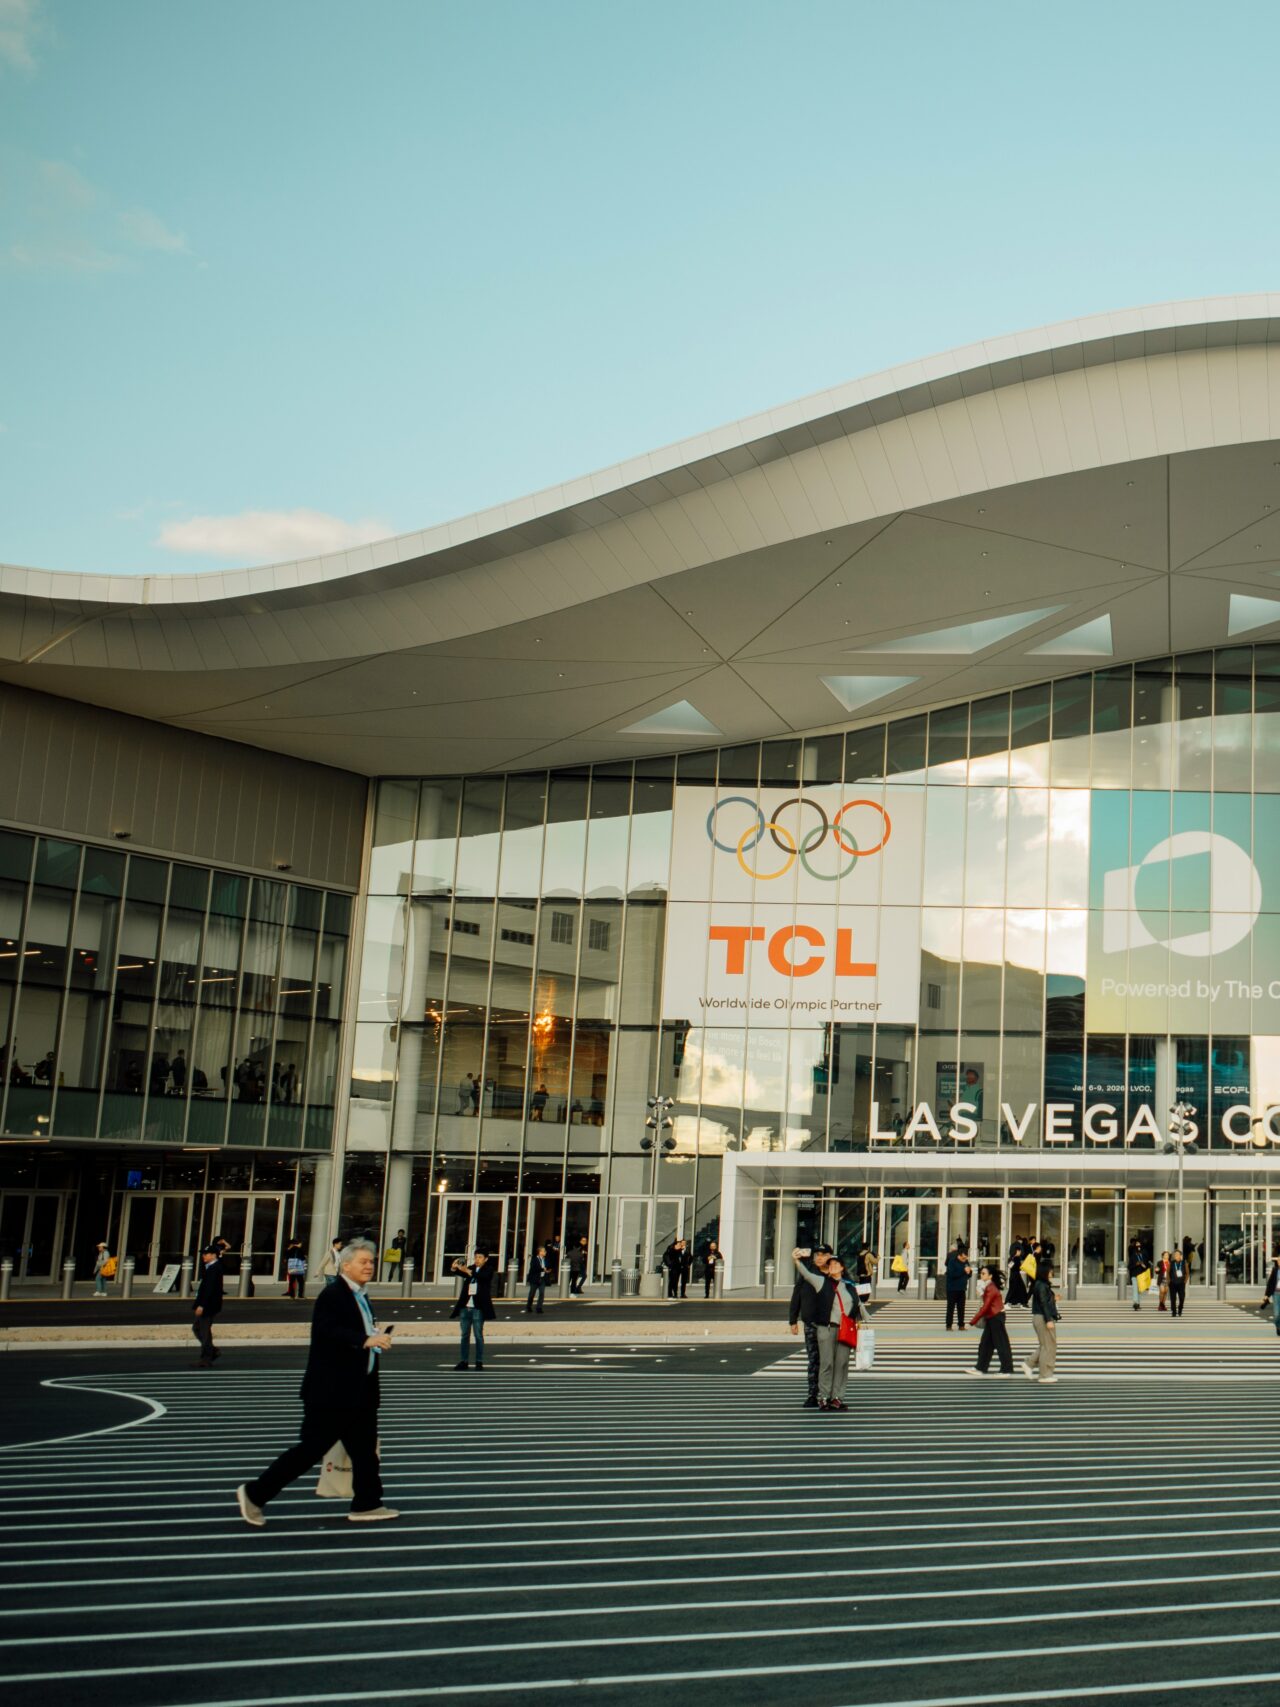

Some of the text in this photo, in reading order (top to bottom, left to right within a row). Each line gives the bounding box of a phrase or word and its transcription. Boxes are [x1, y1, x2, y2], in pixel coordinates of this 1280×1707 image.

[708, 925, 877, 977] TCL
[1101, 978, 1191, 998] Powered
[1196, 980, 1221, 1003] by
[1224, 980, 1263, 999] The
[698, 997, 882, 1012] Worldwide Olympic Partner
[1175, 1086, 1194, 1094] egas
[1214, 1086, 1251, 1094] ECOFL
[869, 1101, 979, 1141] LAS
[1001, 1102, 1199, 1143] VEGAS
